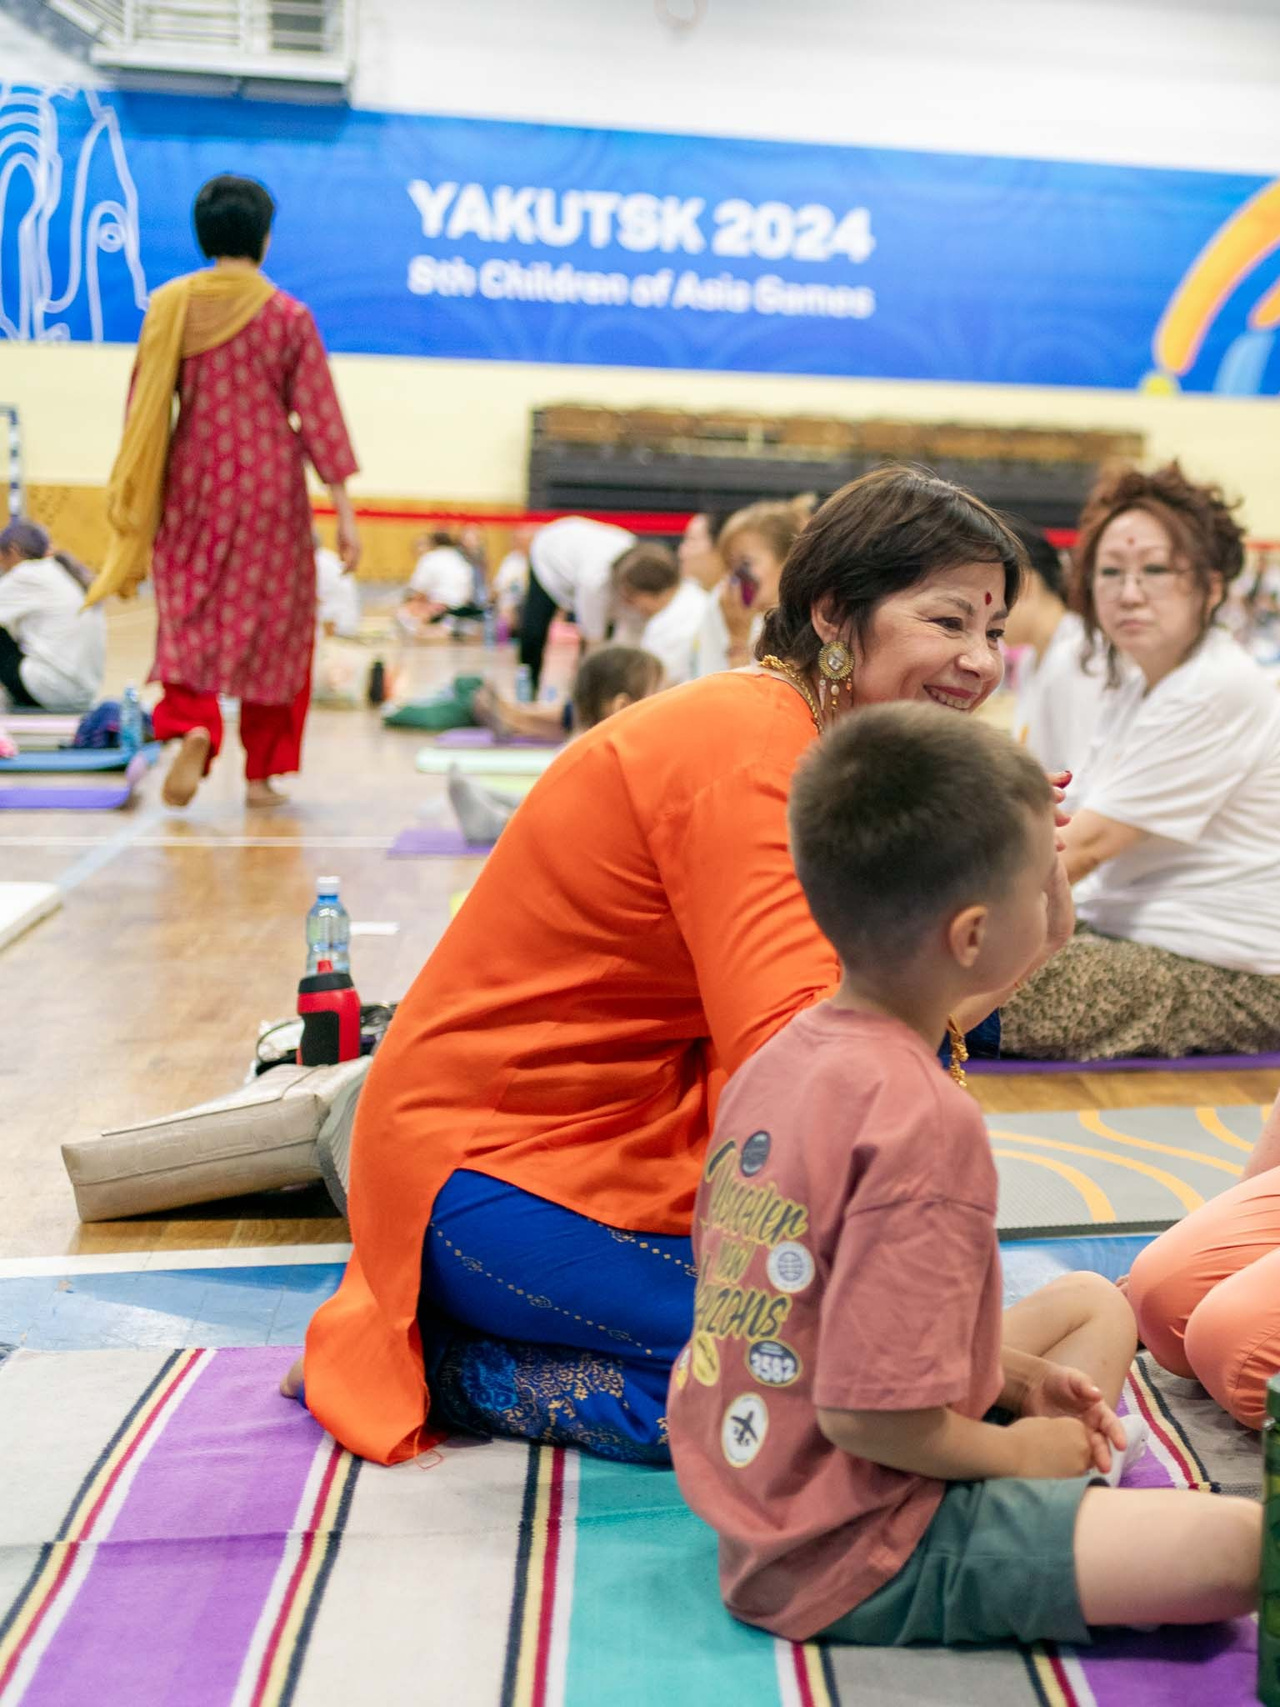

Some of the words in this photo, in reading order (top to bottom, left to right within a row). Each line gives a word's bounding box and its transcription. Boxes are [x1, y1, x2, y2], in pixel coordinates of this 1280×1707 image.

[408, 180, 705, 254] YAKUTSK
[713, 200, 876, 263] 2024
[480, 259, 629, 307] Children
[631, 269, 672, 308] of
[672, 270, 750, 313] Asia
[754, 275, 876, 319] Games
